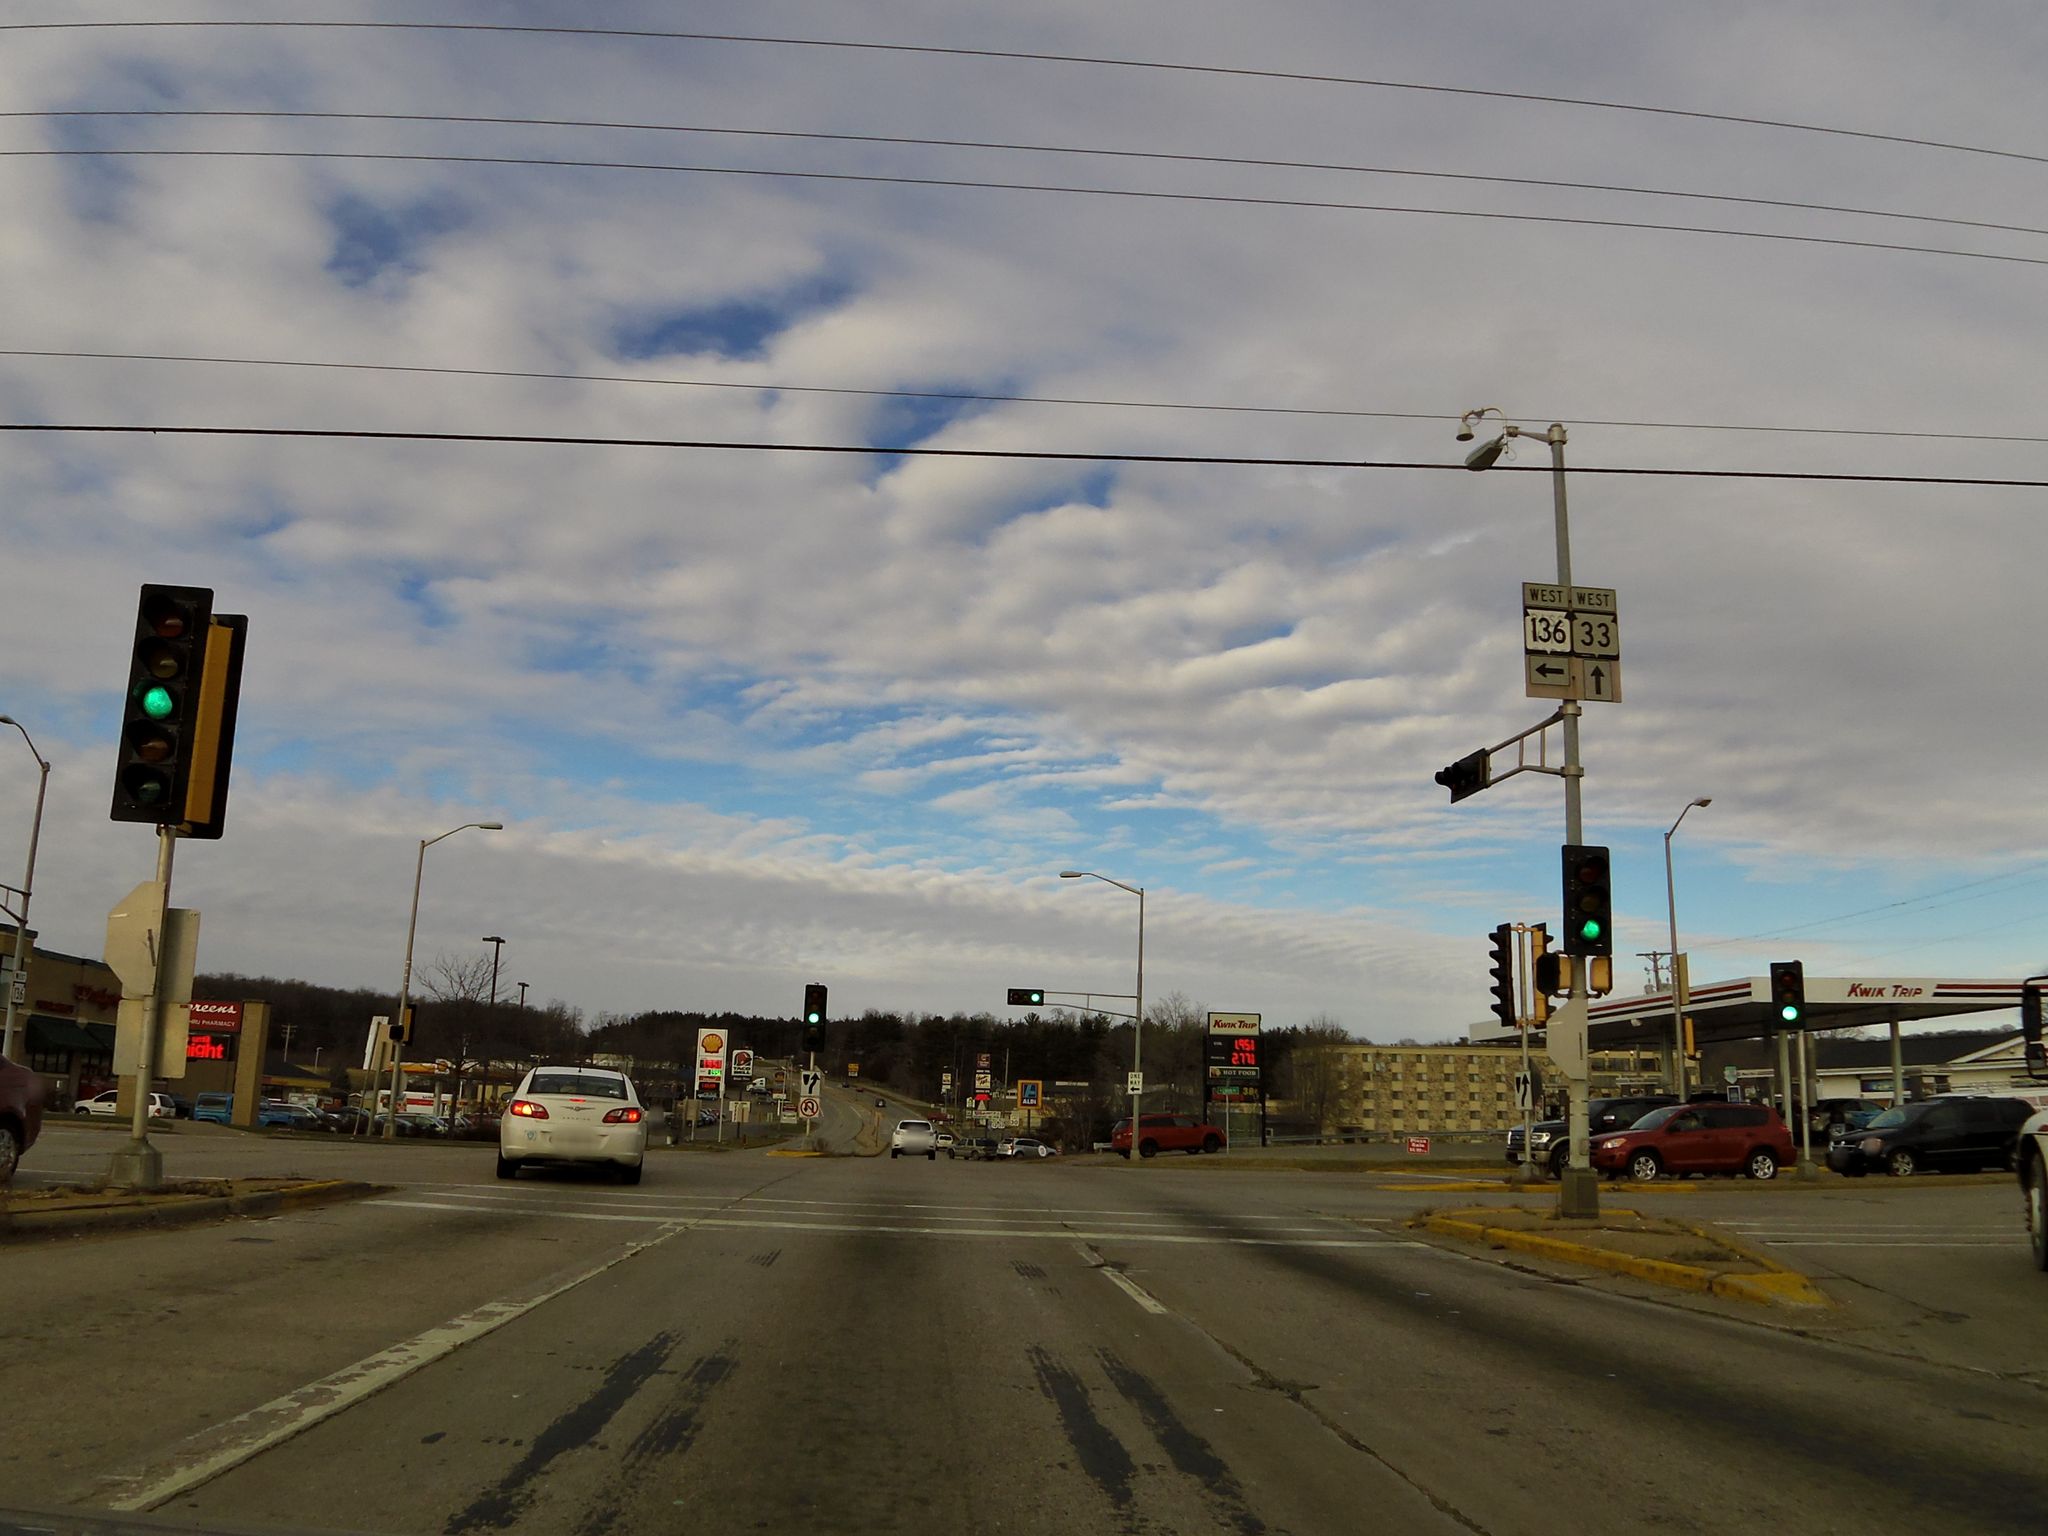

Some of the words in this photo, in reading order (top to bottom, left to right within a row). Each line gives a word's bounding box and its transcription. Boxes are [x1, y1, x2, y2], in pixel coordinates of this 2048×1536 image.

[1529, 588, 1563, 603] WEST
[1576, 592, 1610, 607] WEST
[1531, 617, 1566, 644] 136
[1581, 621, 1611, 648] 33
[1847, 983, 1886, 997] KWIK
[1892, 985, 1923, 997] TRIP
[1238, 1020, 1257, 1029] TRIP
